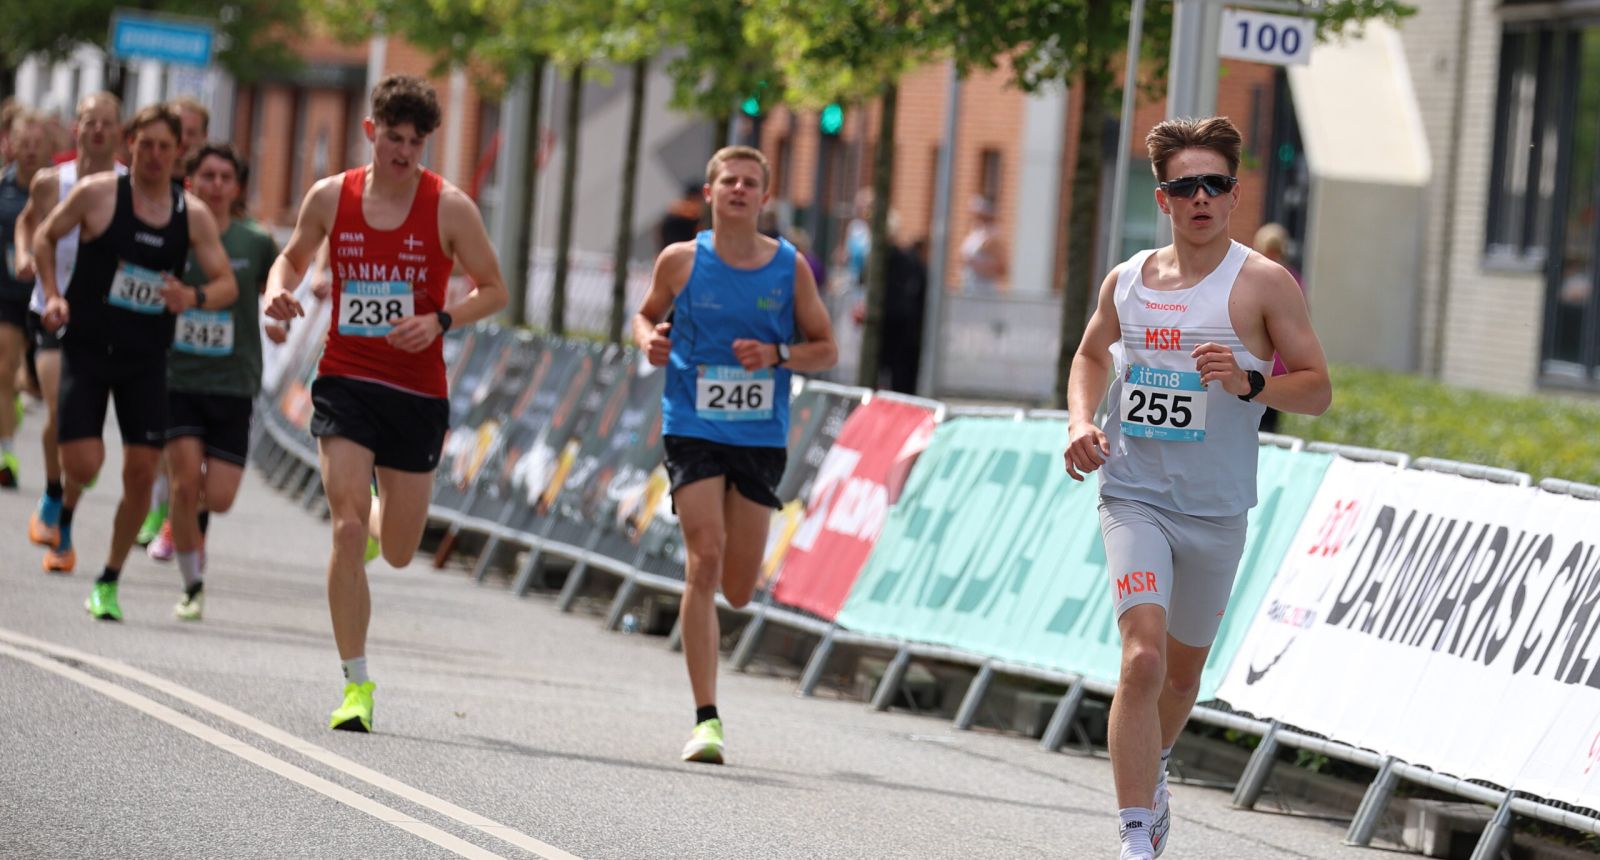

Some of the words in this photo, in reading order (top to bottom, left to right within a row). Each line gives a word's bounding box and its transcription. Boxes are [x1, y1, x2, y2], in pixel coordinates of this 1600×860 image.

[1237, 20, 1301, 55] 100
[337, 262, 429, 282] DANMARK
[348, 298, 404, 326] 238
[1145, 302, 1188, 313] saucony
[183, 320, 225, 348] 242
[1145, 328, 1181, 351] MSR
[1139, 366, 1180, 388] itm8
[708, 384, 763, 409] 246
[1127, 389, 1193, 428] 255
[1117, 571, 1158, 600] MSR
[1325, 504, 1553, 666] DANMARKS
[1126, 821, 1143, 829] MSR
